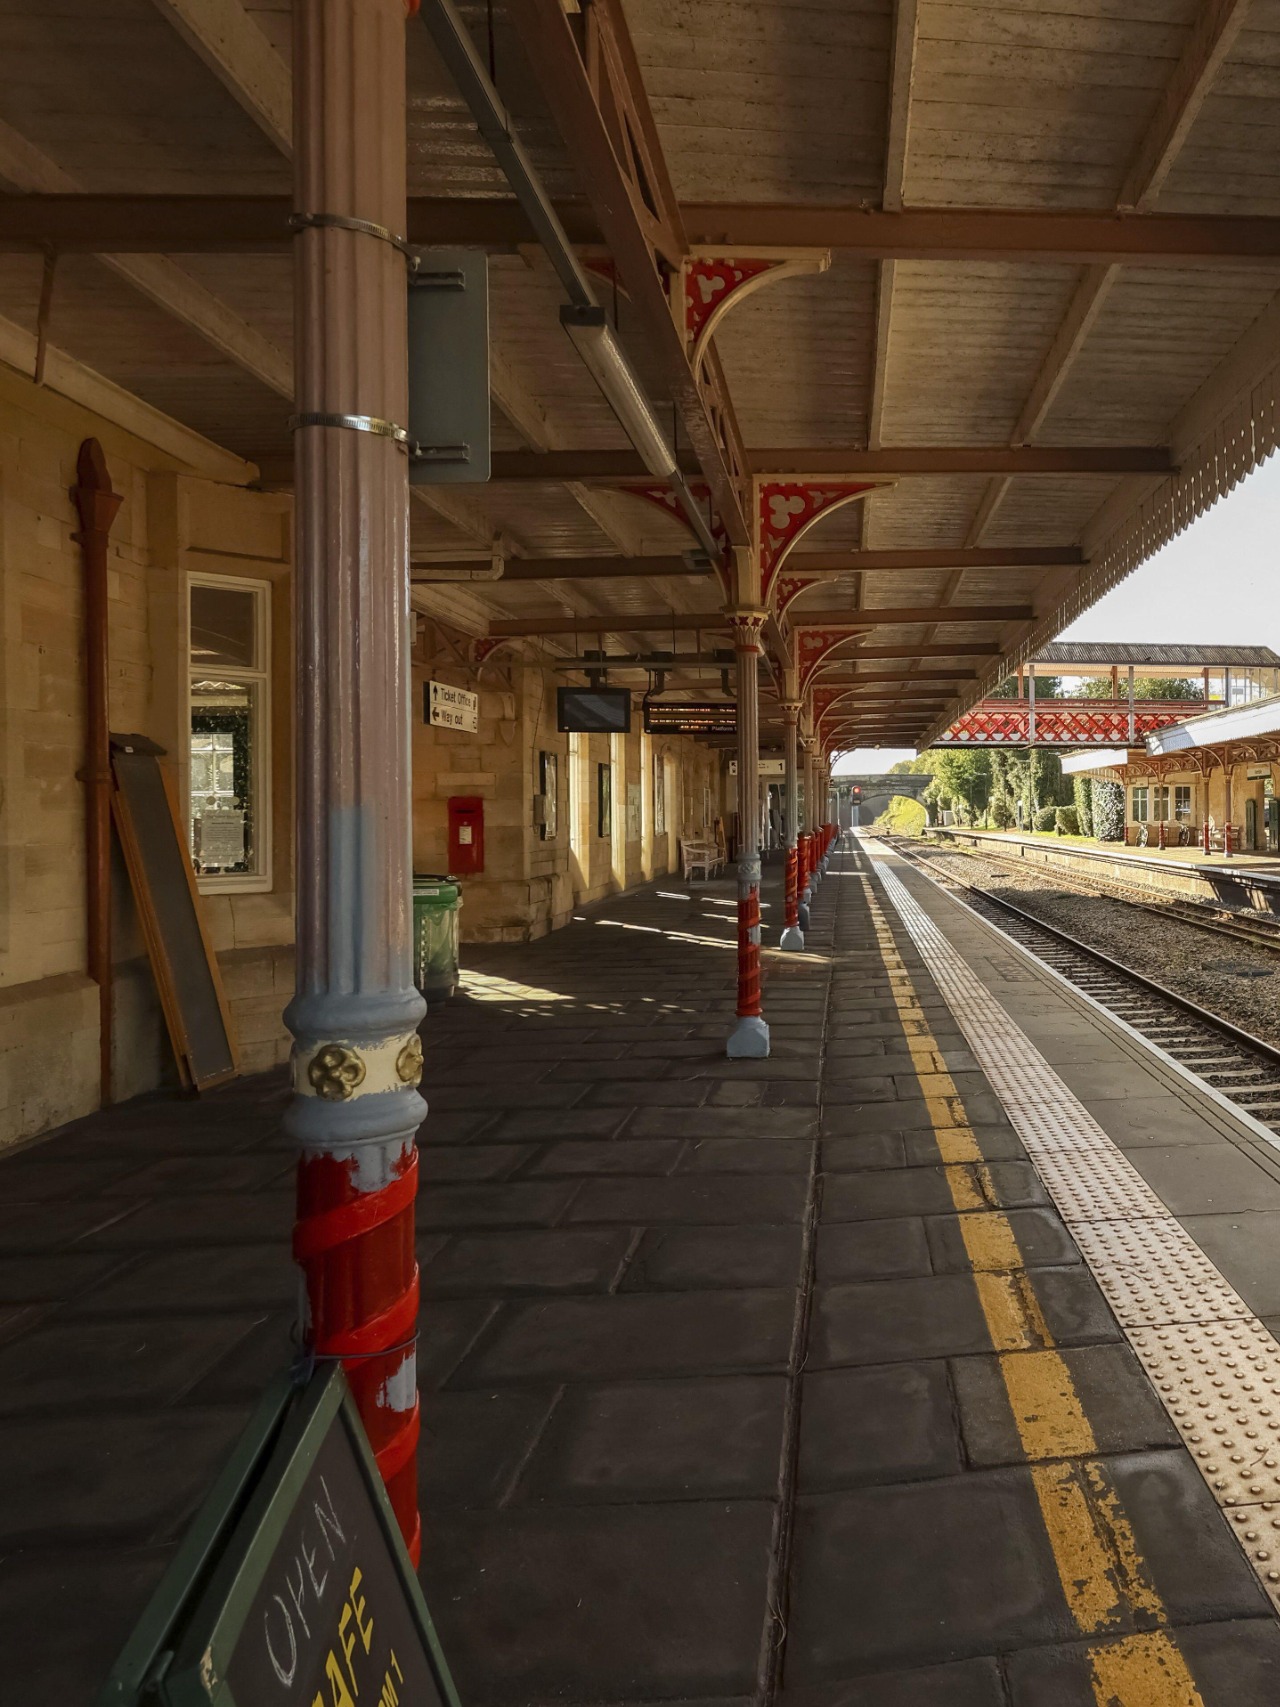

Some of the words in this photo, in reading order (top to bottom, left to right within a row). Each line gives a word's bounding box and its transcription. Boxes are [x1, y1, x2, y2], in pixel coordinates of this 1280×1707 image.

[440, 687, 456, 704] Ticket
[457, 692, 471, 708] Office
[441, 709, 453, 726] Way
[454, 713, 464, 726] out
[778, 762, 783, 771] 1
[265, 1475, 347, 1688] OPEN
[311, 1566, 374, 1707] AFE
